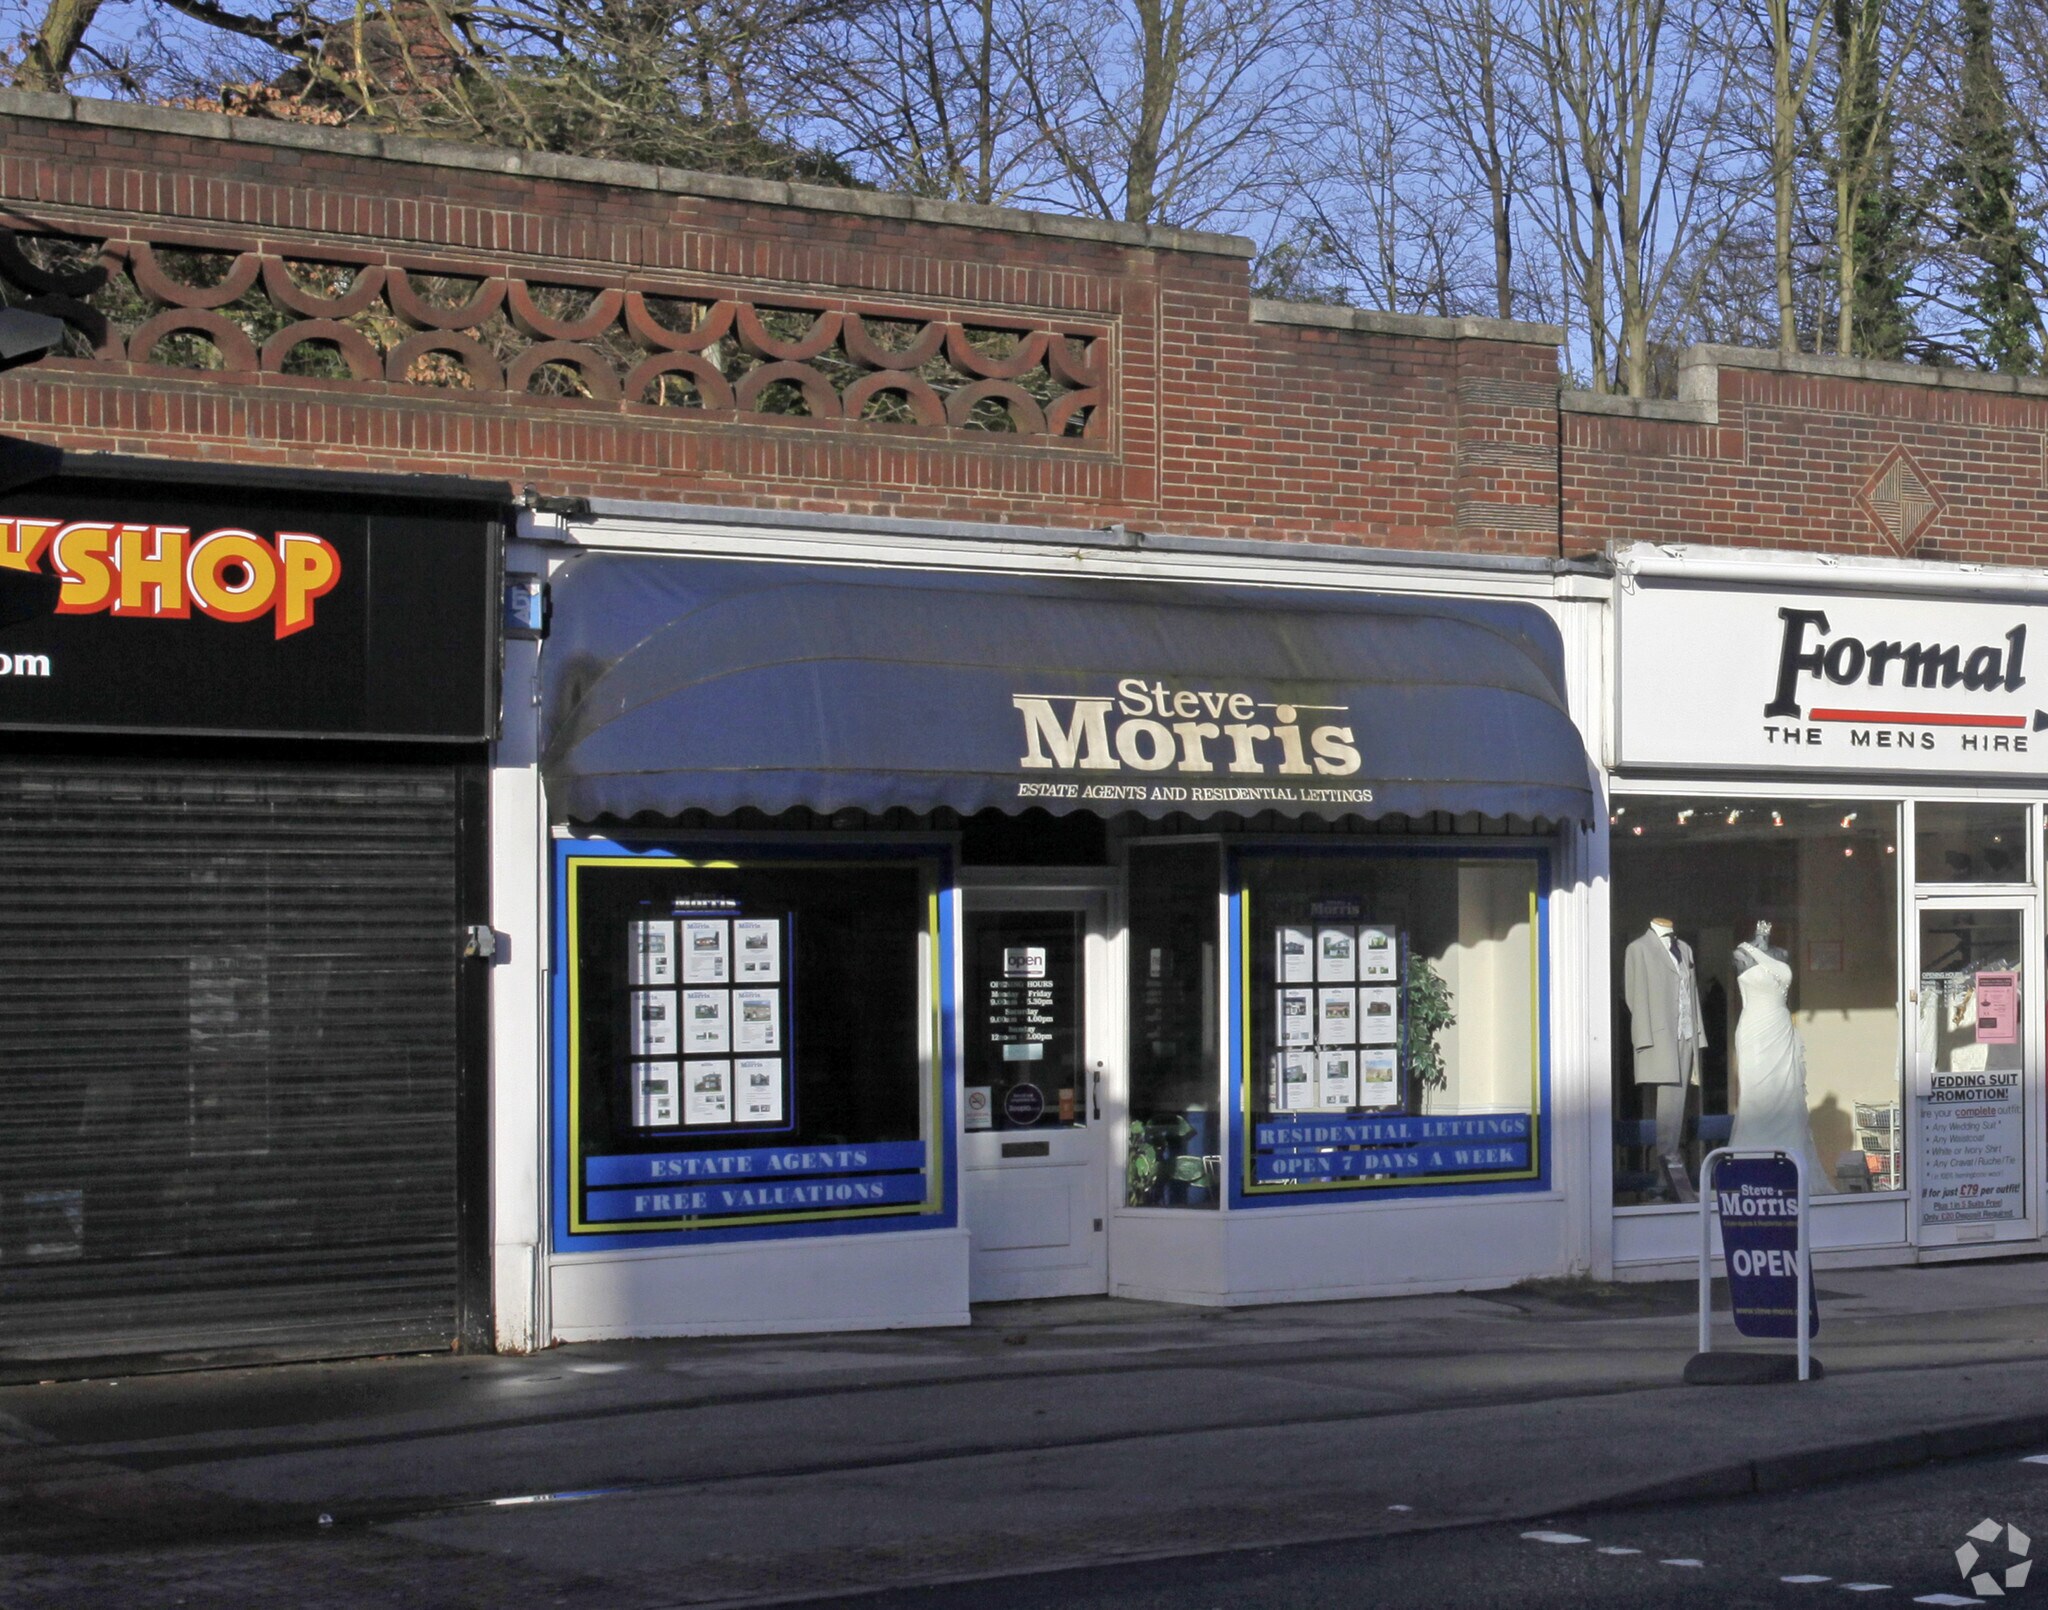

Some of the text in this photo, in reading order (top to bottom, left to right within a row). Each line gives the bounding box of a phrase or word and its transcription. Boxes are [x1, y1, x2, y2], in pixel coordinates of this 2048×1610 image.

[1764, 606, 2027, 719] Formal
[1118, 678, 1255, 720] Steve
[1013, 697, 1362, 776] Morris
[1764, 726, 2028, 752] THE MENS HIRE
[1017, 783, 1373, 802] ESTATE AGENTS AND RESIDENTIAL LETTINGS
[1008, 955, 1042, 968] open
[1028, 990, 1052, 998] Friday
[1989, 1073, 2018, 1085] SUIT
[1928, 1088, 2009, 1102] PROMOTION!
[1934, 1110, 1952, 1119] your
[1955, 1106, 1996, 1118] complete
[1260, 1118, 1525, 1144] RESIDENTIAL LETTINGS
[1932, 1123, 1947, 1132] Any
[1949, 1121, 1980, 1132] Wedding
[1932, 1134, 1985, 1144] Any Waistcoat
[1932, 1147, 1952, 1155] White
[1965, 1146, 1982, 1155] Ivory
[1985, 1144, 2001, 1153] Shirt
[651, 1150, 868, 1177] ESTATE AGENTS
[1272, 1147, 1514, 1174] OPEN 7 DAYS A WEEK
[1933, 1159, 1947, 1168] Any
[634, 1182, 884, 1213] FREE VALUATIONS
[1741, 1184, 1774, 1196] Steve
[1929, 1188, 1941, 1197] for
[1942, 1187, 1958, 1199] just
[1960, 1184, 1979, 1196] £79
[1980, 1187, 1994, 1197] per
[1720, 1190, 1798, 1216] Morris
[1967, 1199, 1984, 1208] Suits
[1733, 1249, 1798, 1276] OPEN
